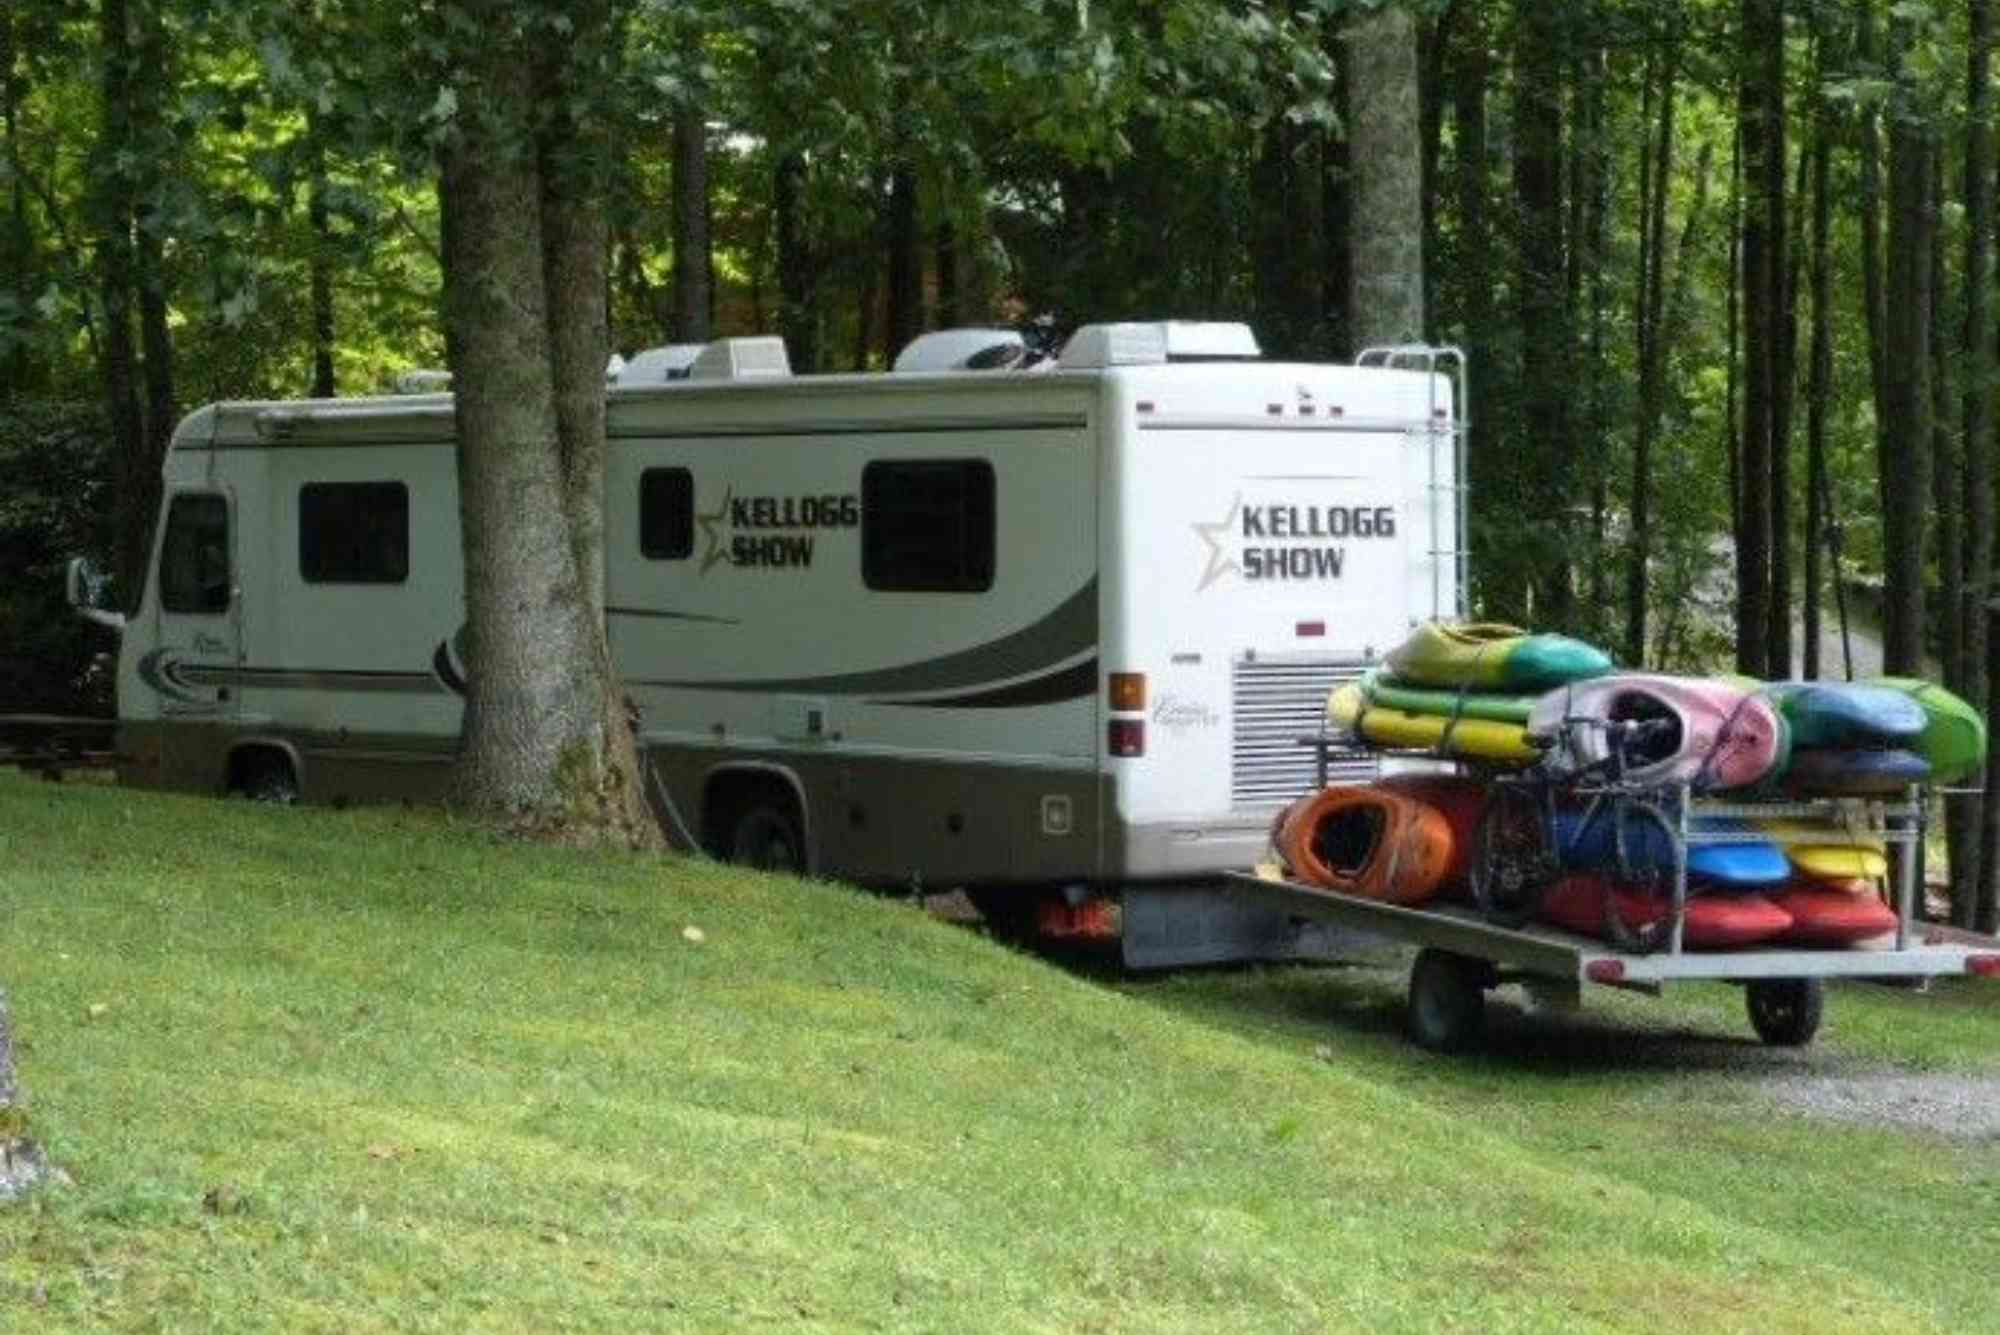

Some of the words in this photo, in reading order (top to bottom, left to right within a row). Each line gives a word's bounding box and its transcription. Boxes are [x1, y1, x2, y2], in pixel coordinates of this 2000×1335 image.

[732, 496, 859, 527] KELLOGG
[1242, 505, 1395, 538] KELLOGG
[732, 535, 813, 566] SHOW
[1242, 547, 1344, 579] SHOW
